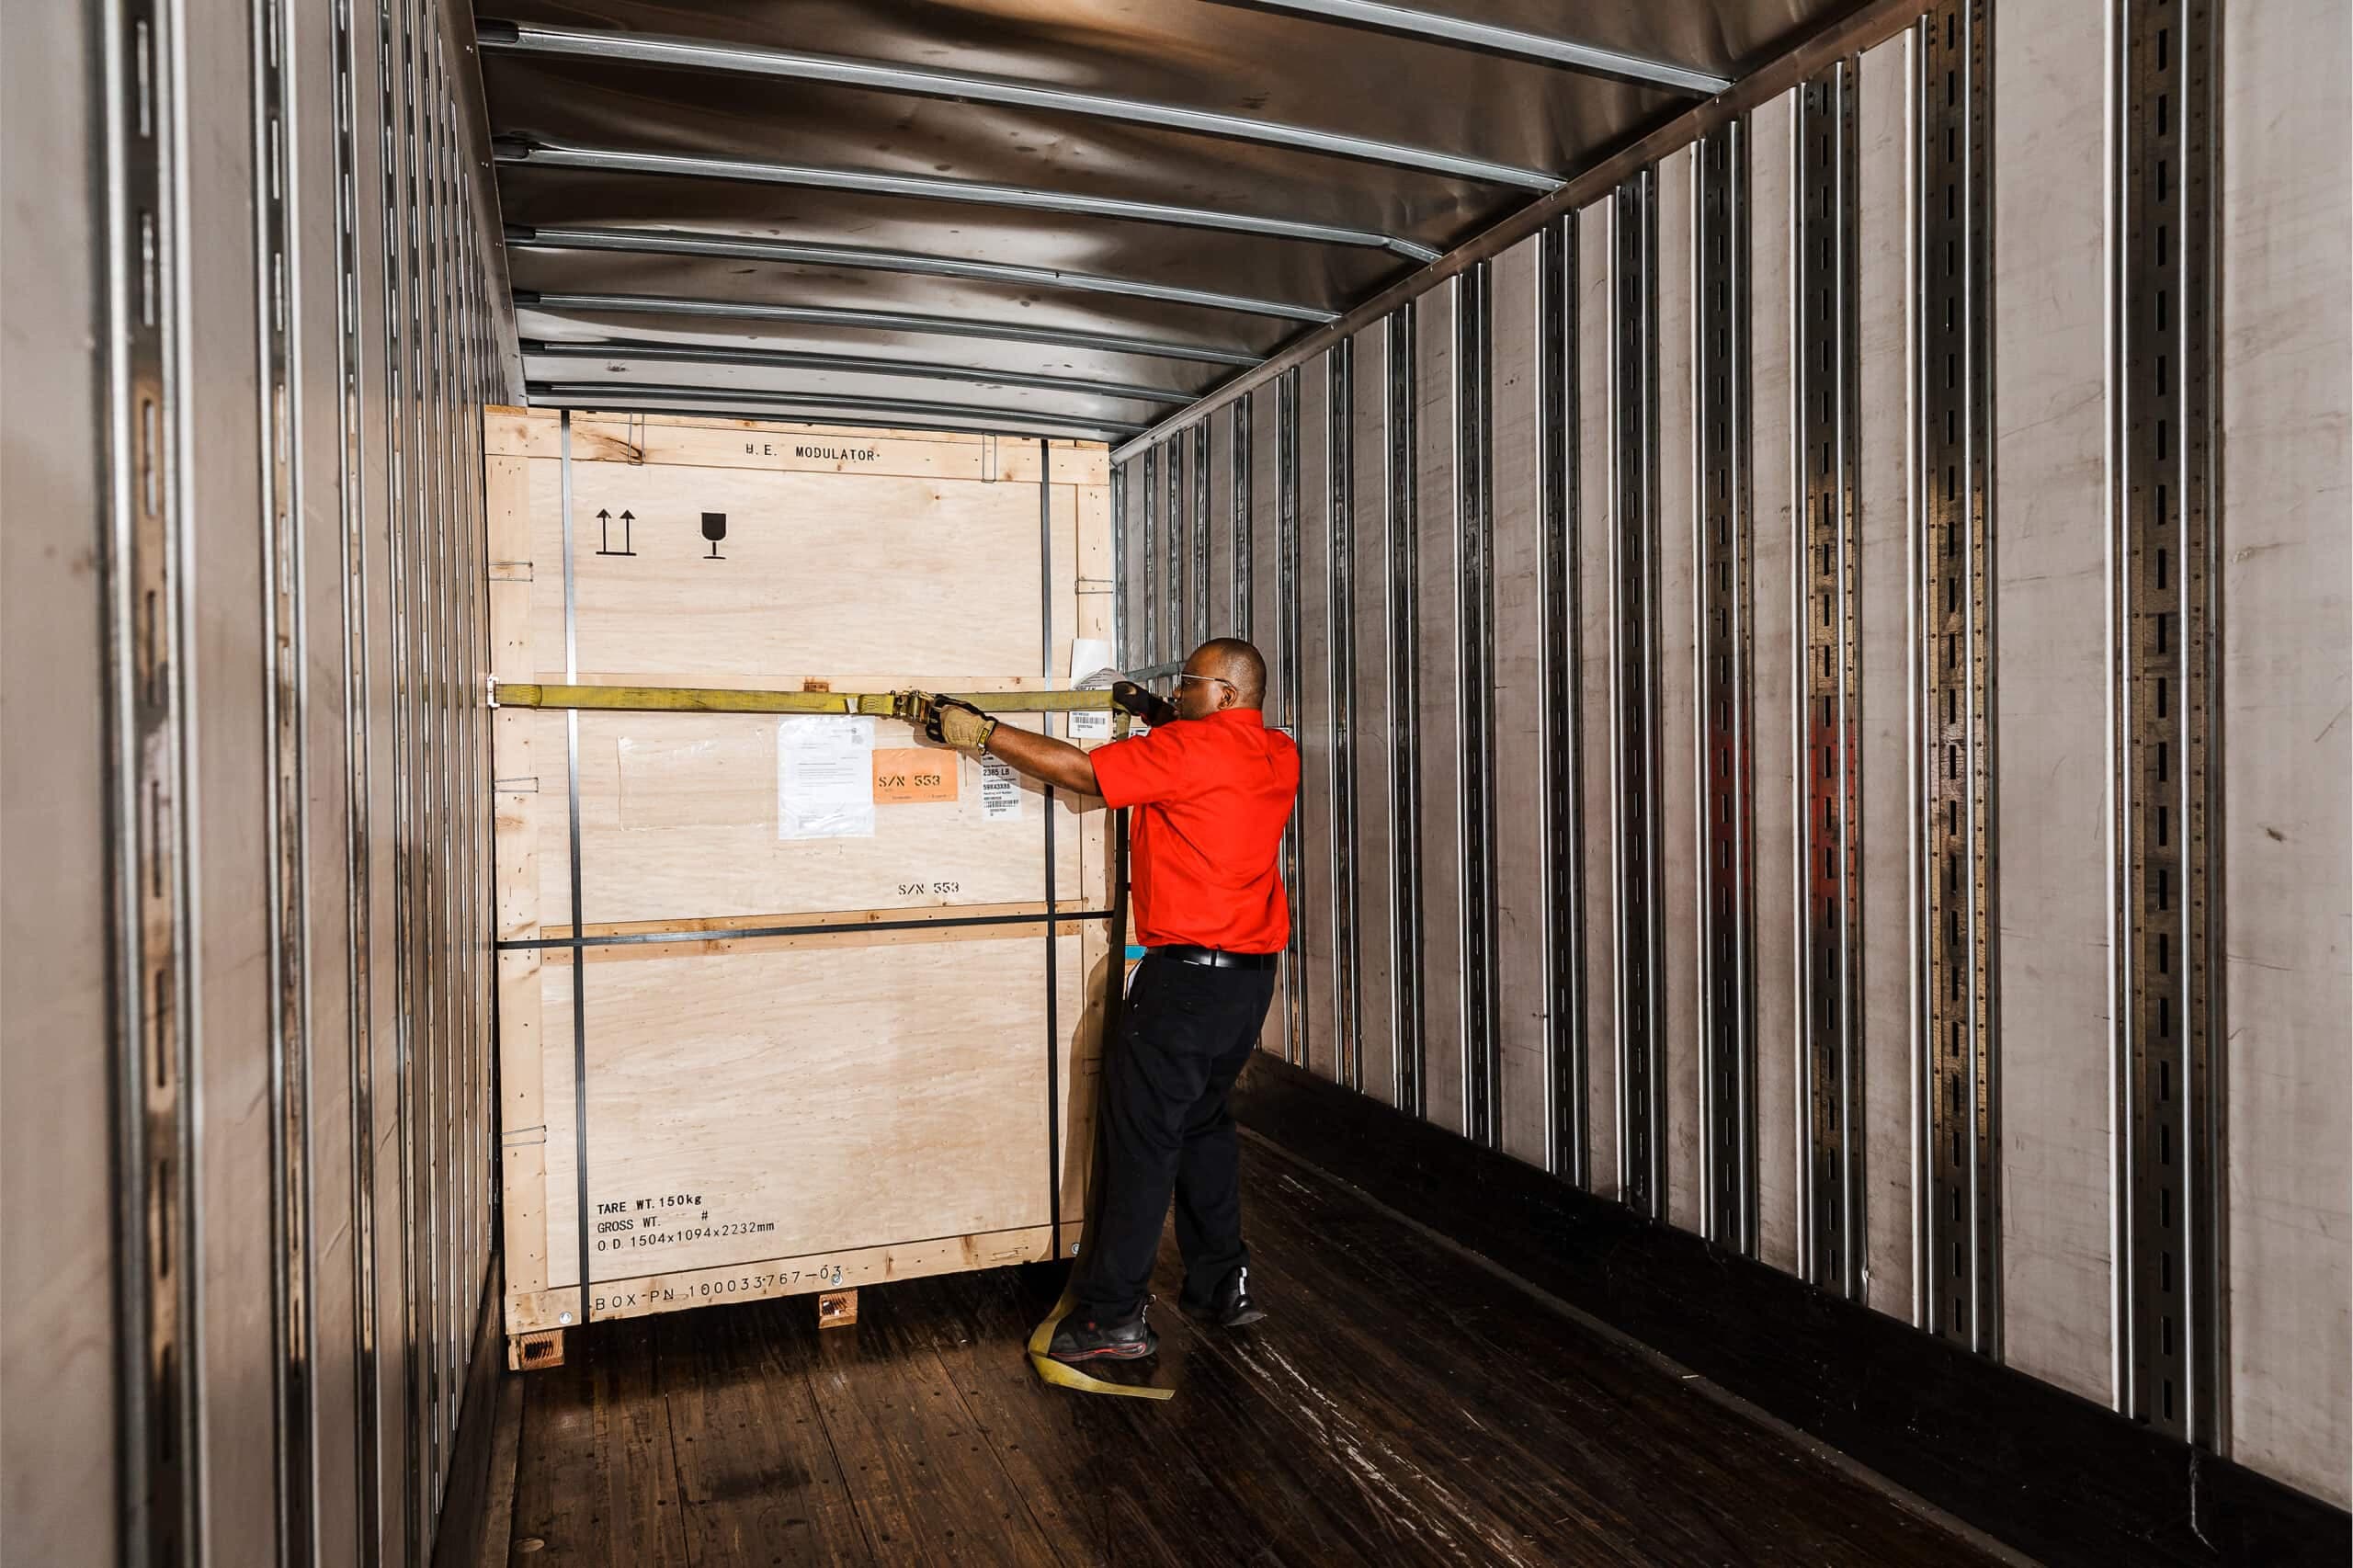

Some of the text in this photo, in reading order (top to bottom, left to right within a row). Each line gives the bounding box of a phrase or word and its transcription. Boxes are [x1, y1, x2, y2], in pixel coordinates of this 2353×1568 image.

[795, 446, 875, 461] MODULATOR
[1001, 767, 1010, 776] LB
[878, 774, 941, 788] S/N 553
[897, 881, 960, 896] S/N 553
[597, 1201, 627, 1215] TARE
[597, 1219, 634, 1233] GROSS
[642, 1216, 661, 1228] WT.
[595, 1293, 636, 1311] BOX
